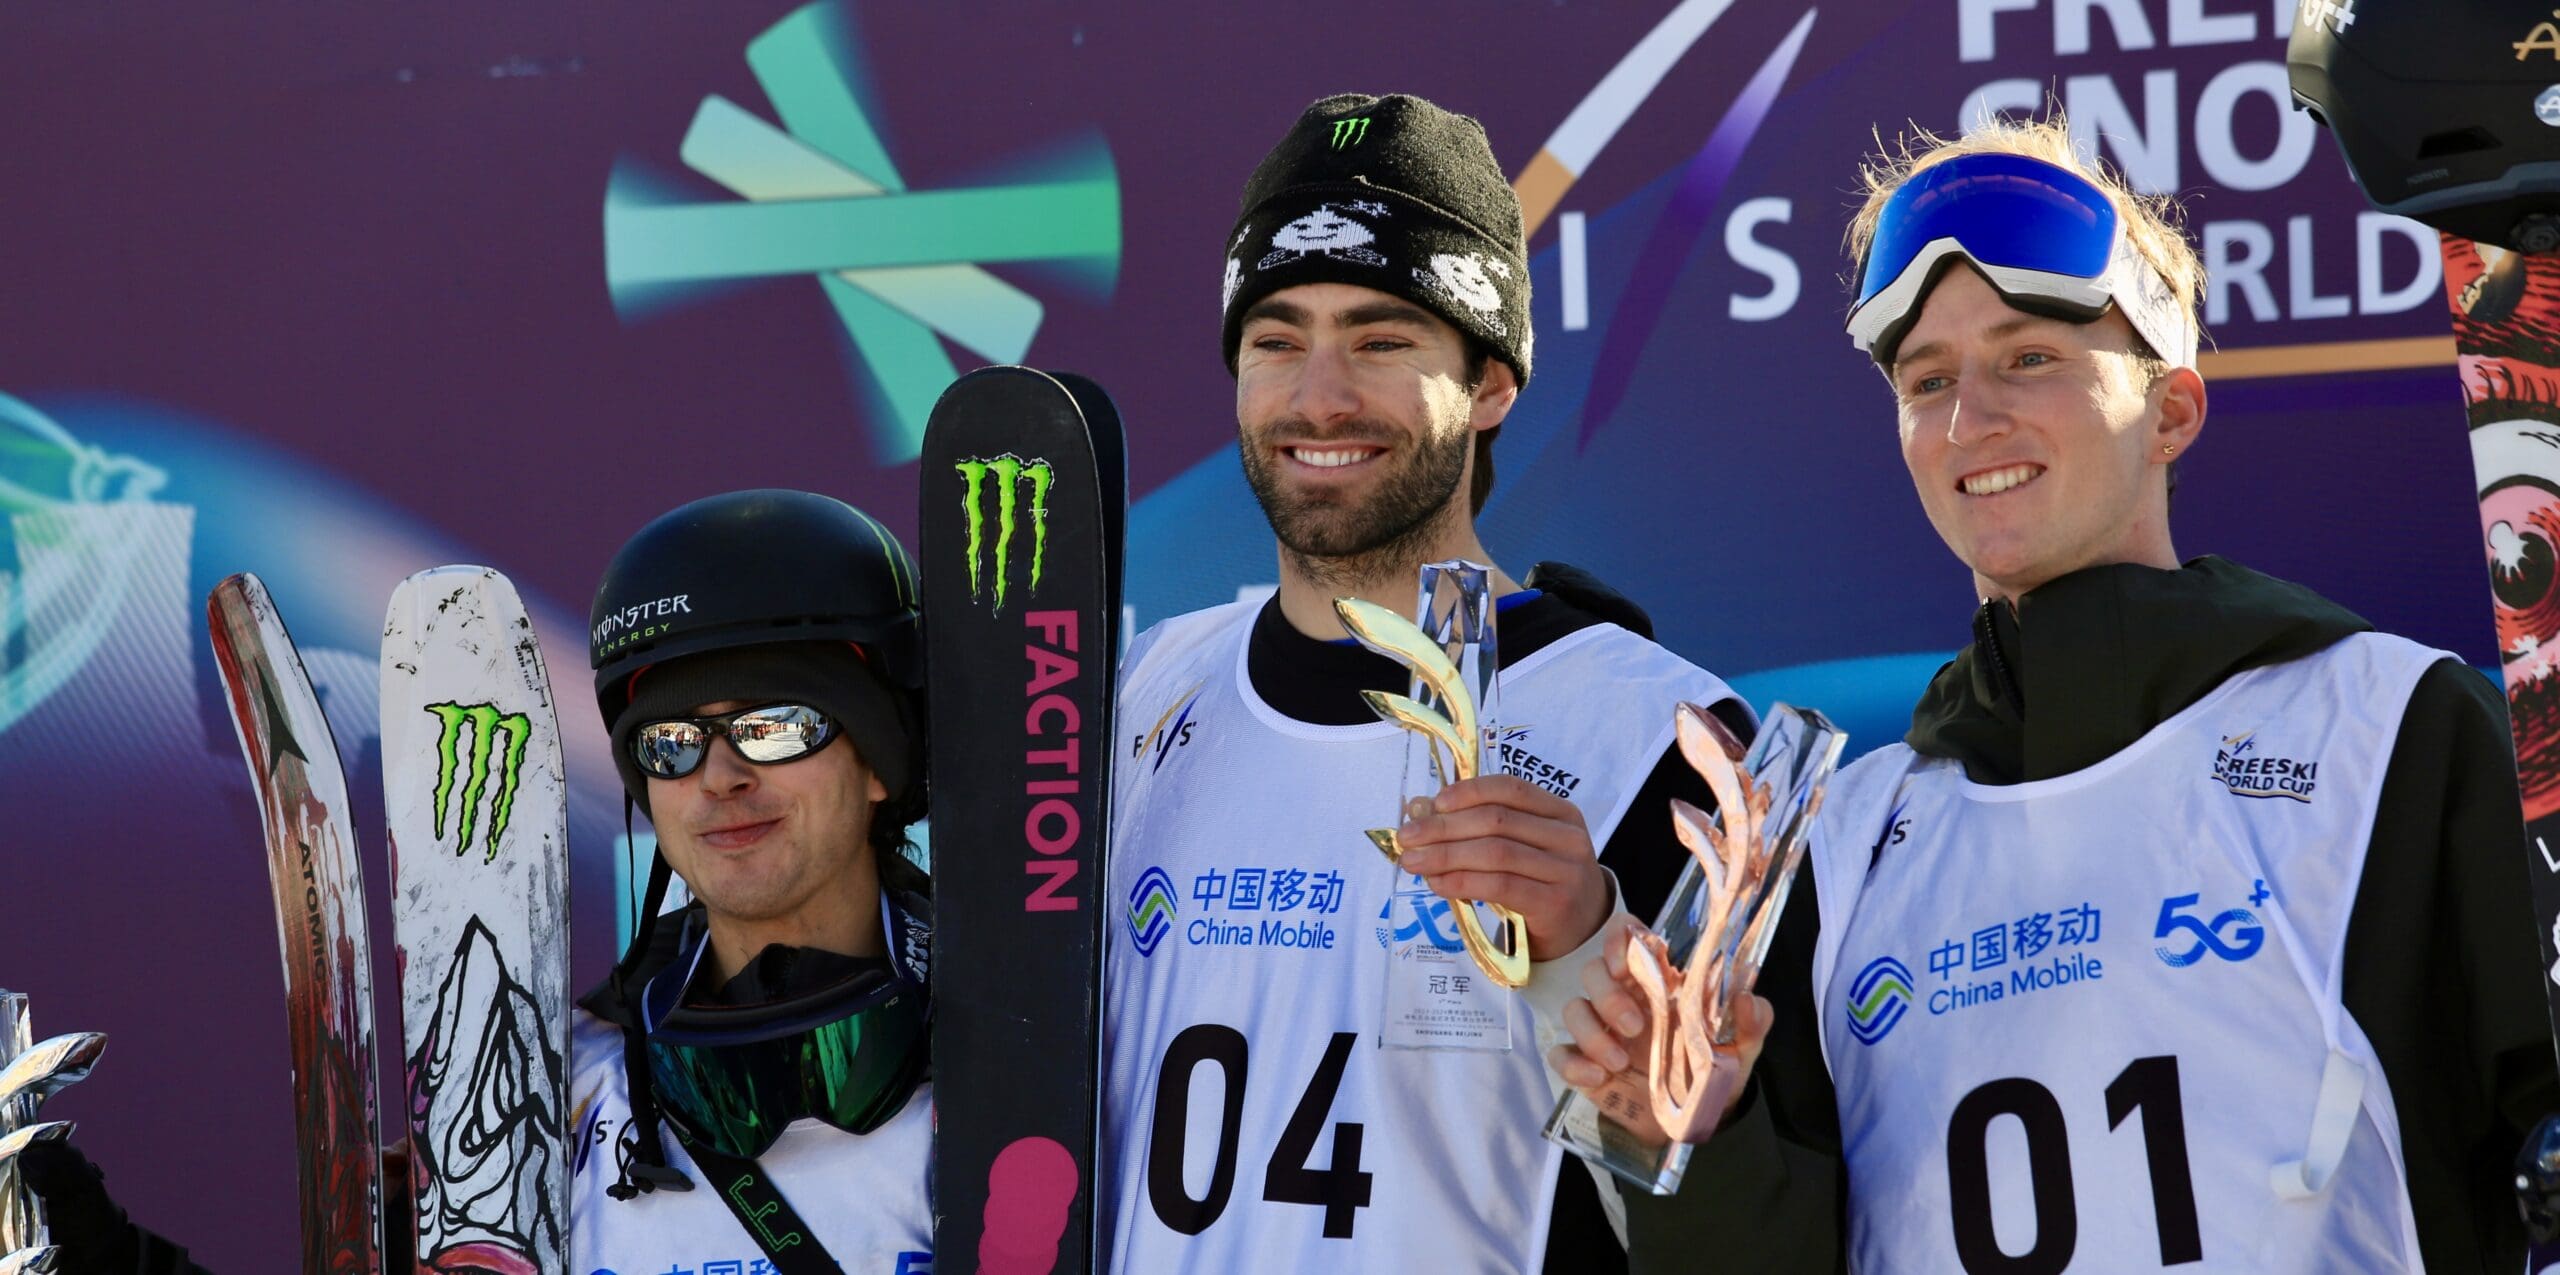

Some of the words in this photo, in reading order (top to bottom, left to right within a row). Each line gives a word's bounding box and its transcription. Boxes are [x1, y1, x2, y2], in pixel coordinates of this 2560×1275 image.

[592, 594, 693, 647] MONSTER
[600, 622, 670, 657] ENERGY
[1025, 609, 1081, 913] FACTION
[1133, 721, 1197, 758] FIS
[1500, 743, 1581, 791] REESKI
[2213, 761, 2275, 791] WORLD
[2279, 777, 2315, 796] CUP
[2216, 749, 2318, 781] FREESKI
[298, 839, 327, 983] ATOMIC
[1192, 867, 1345, 914] 中国移动
[1187, 917, 1253, 946] China
[1258, 919, 1335, 949] Mobile
[1928, 901, 2102, 982] 中国移动
[1428, 975, 1471, 995] 冠军
[1928, 976, 2005, 1017] China
[2009, 952, 2104, 997] Mobile
[1147, 1023, 1373, 1240] 04
[1946, 1054, 2203, 1275] 01
